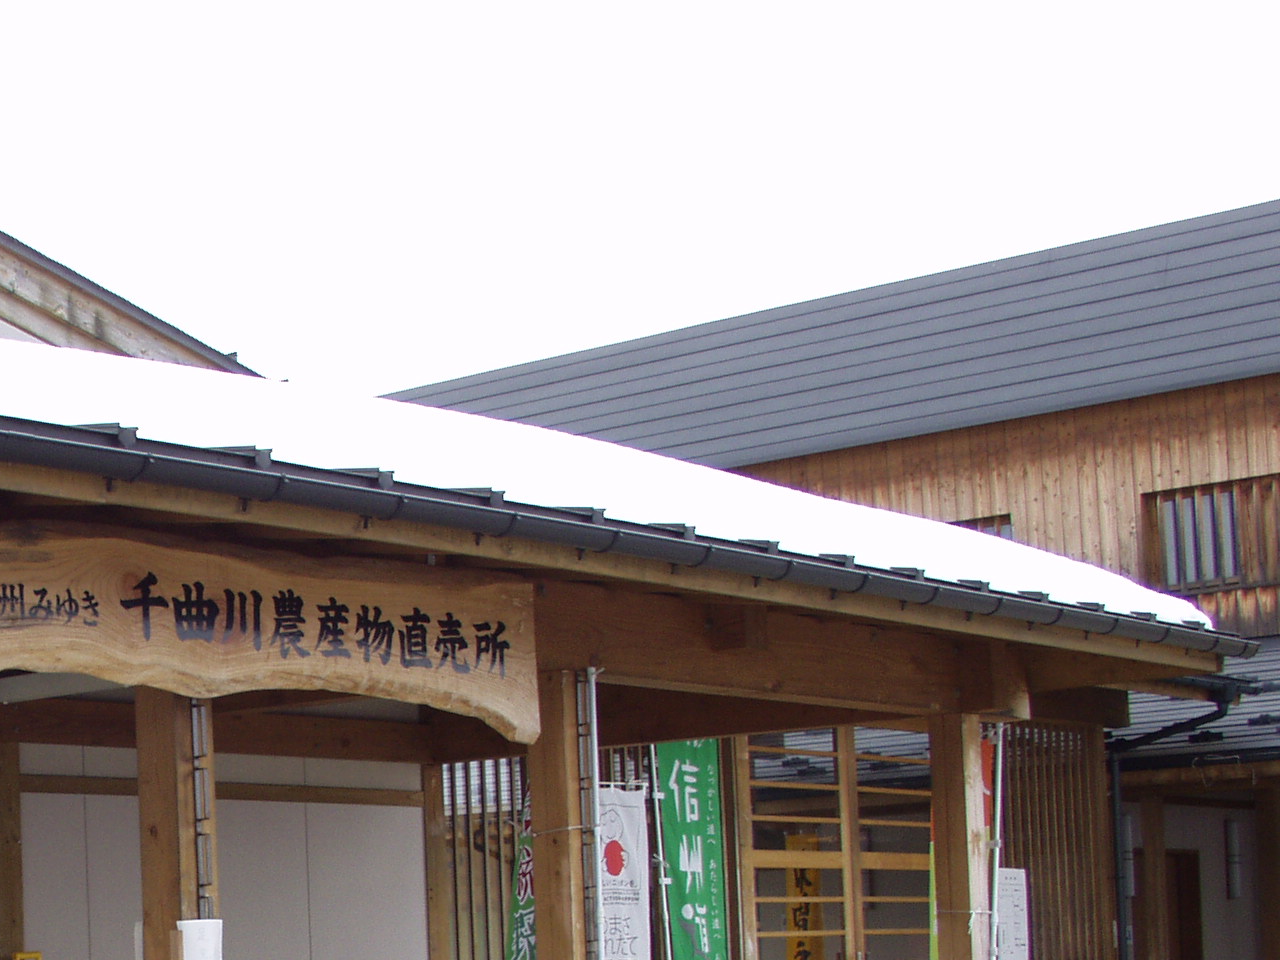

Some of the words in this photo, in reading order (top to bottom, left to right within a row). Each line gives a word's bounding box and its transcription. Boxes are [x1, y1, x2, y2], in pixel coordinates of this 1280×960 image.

[120, 571, 509, 678] 千曲川農産物直売所
